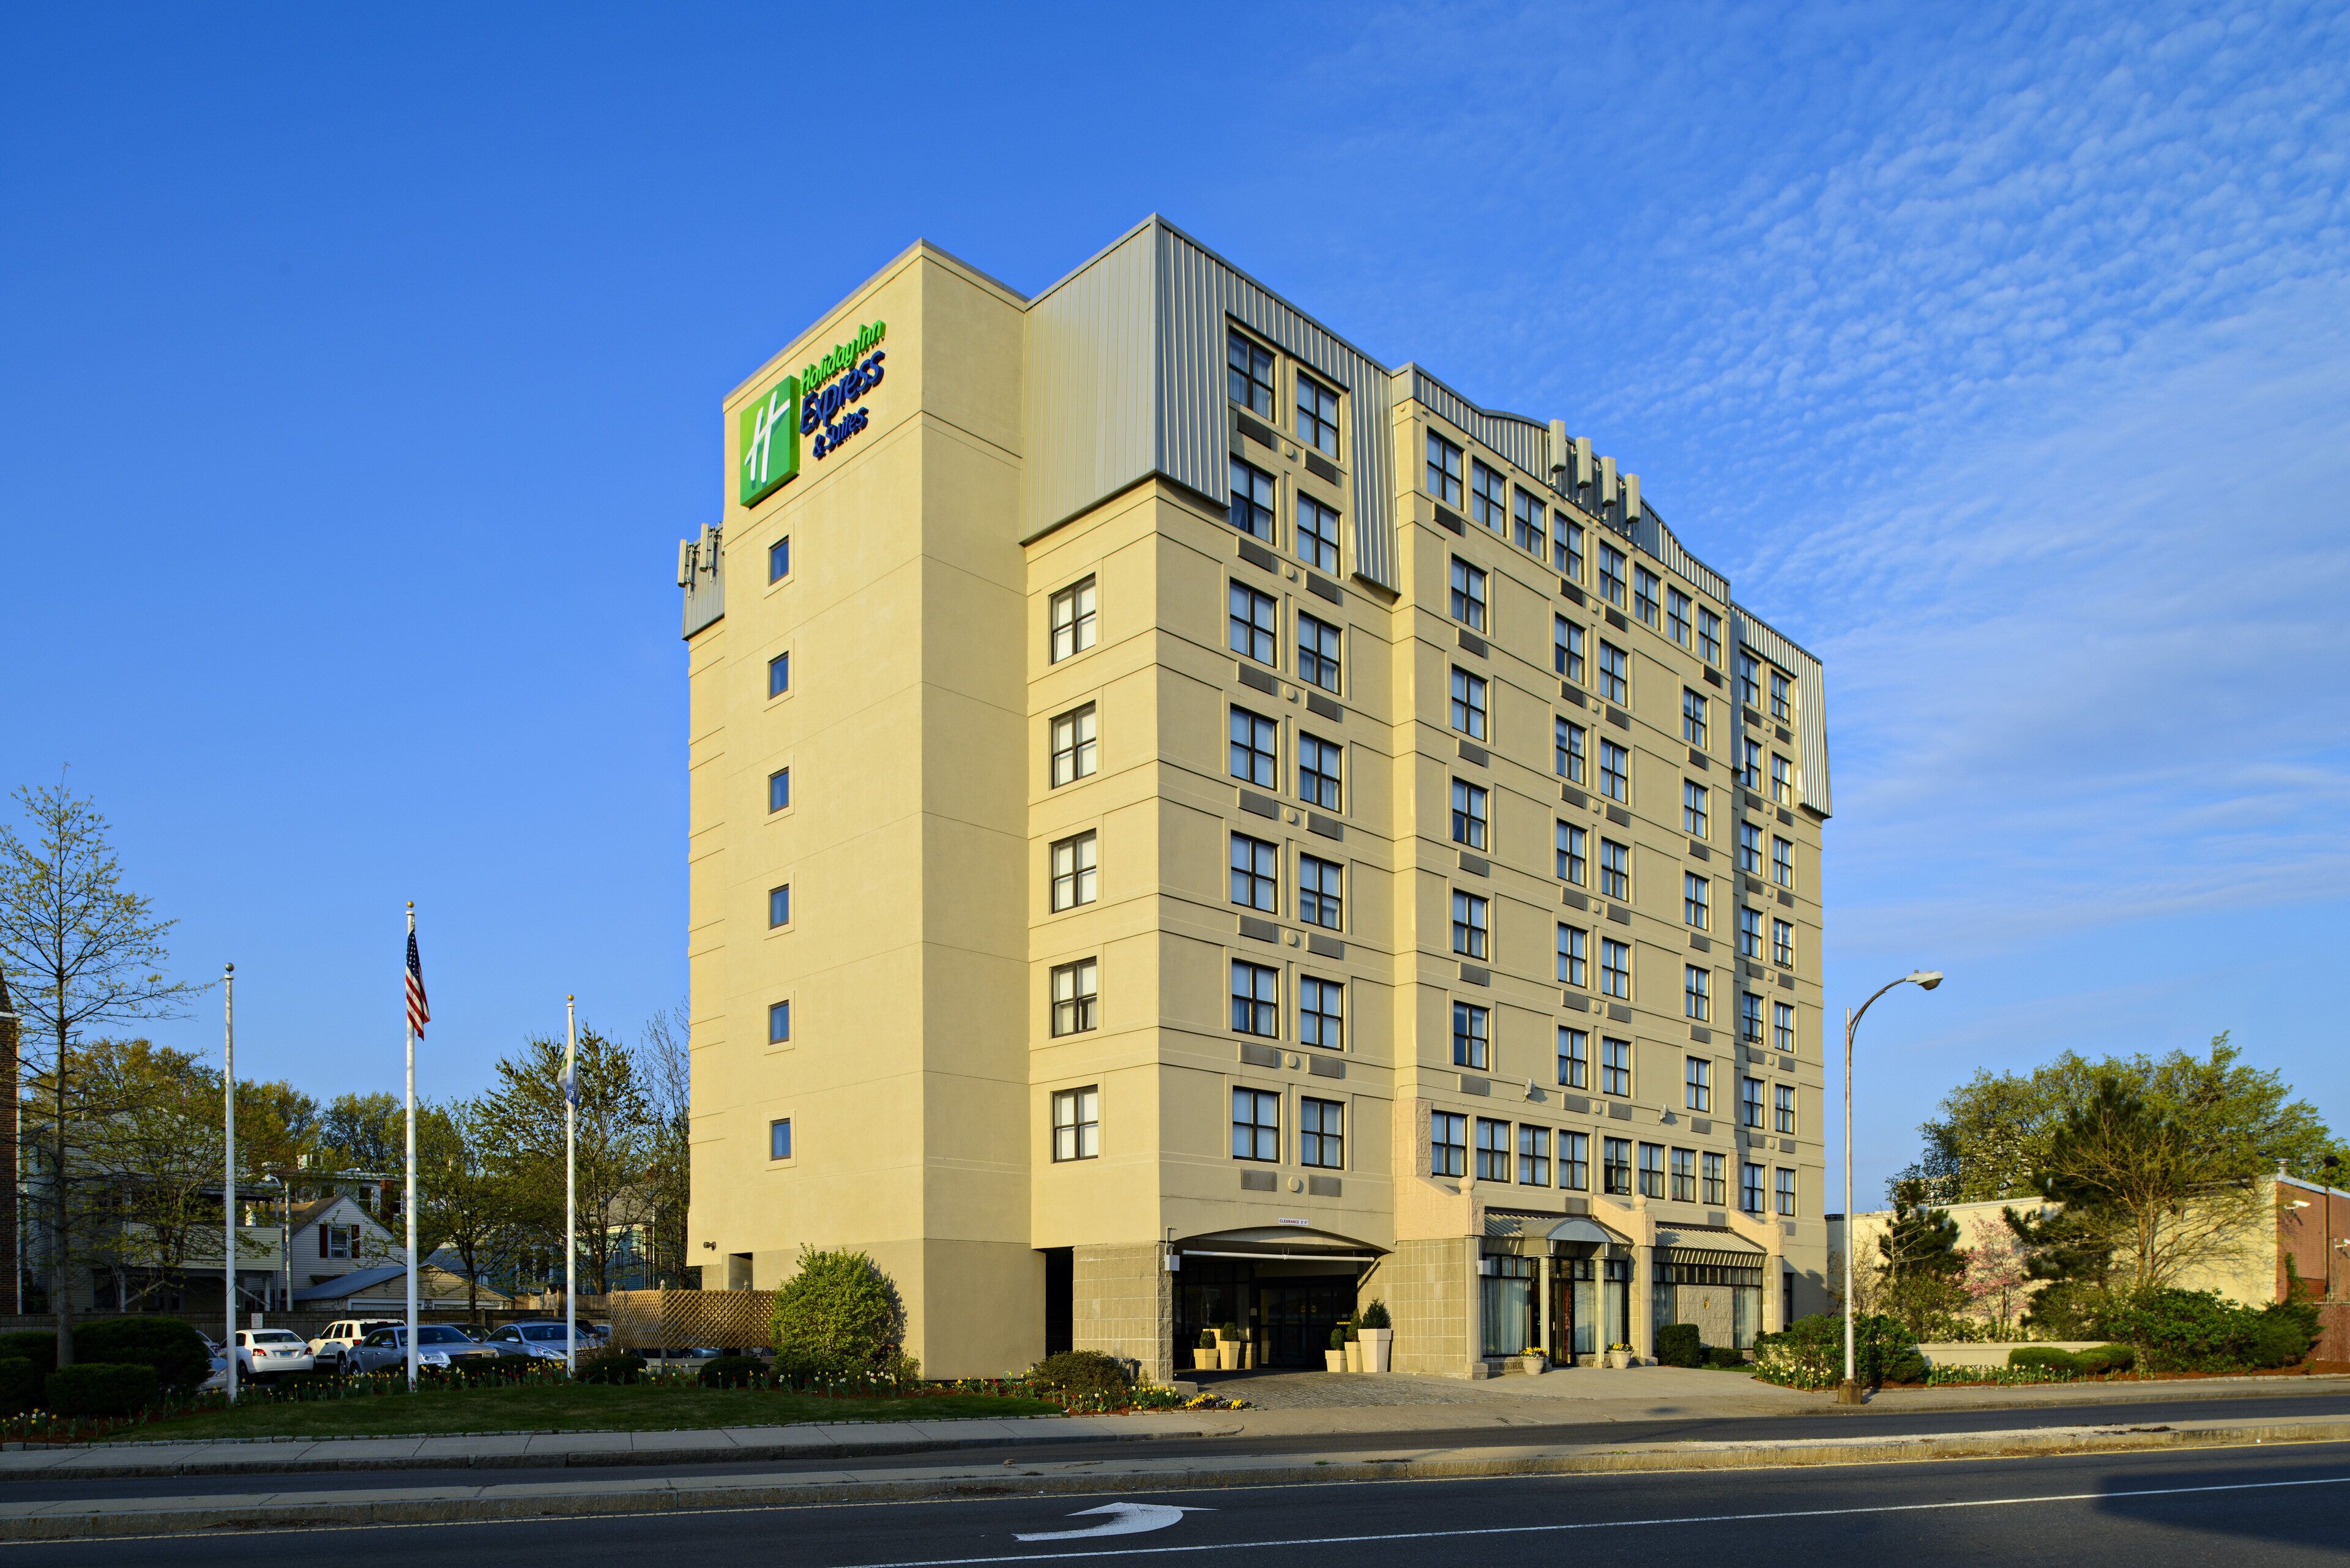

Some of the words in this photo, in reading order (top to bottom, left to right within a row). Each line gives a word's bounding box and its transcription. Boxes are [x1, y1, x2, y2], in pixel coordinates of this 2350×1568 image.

[800, 338, 858, 397] Holiday
[857, 319, 886, 354] Inn
[800, 351, 886, 436] Express
[813, 434, 826, 460] &
